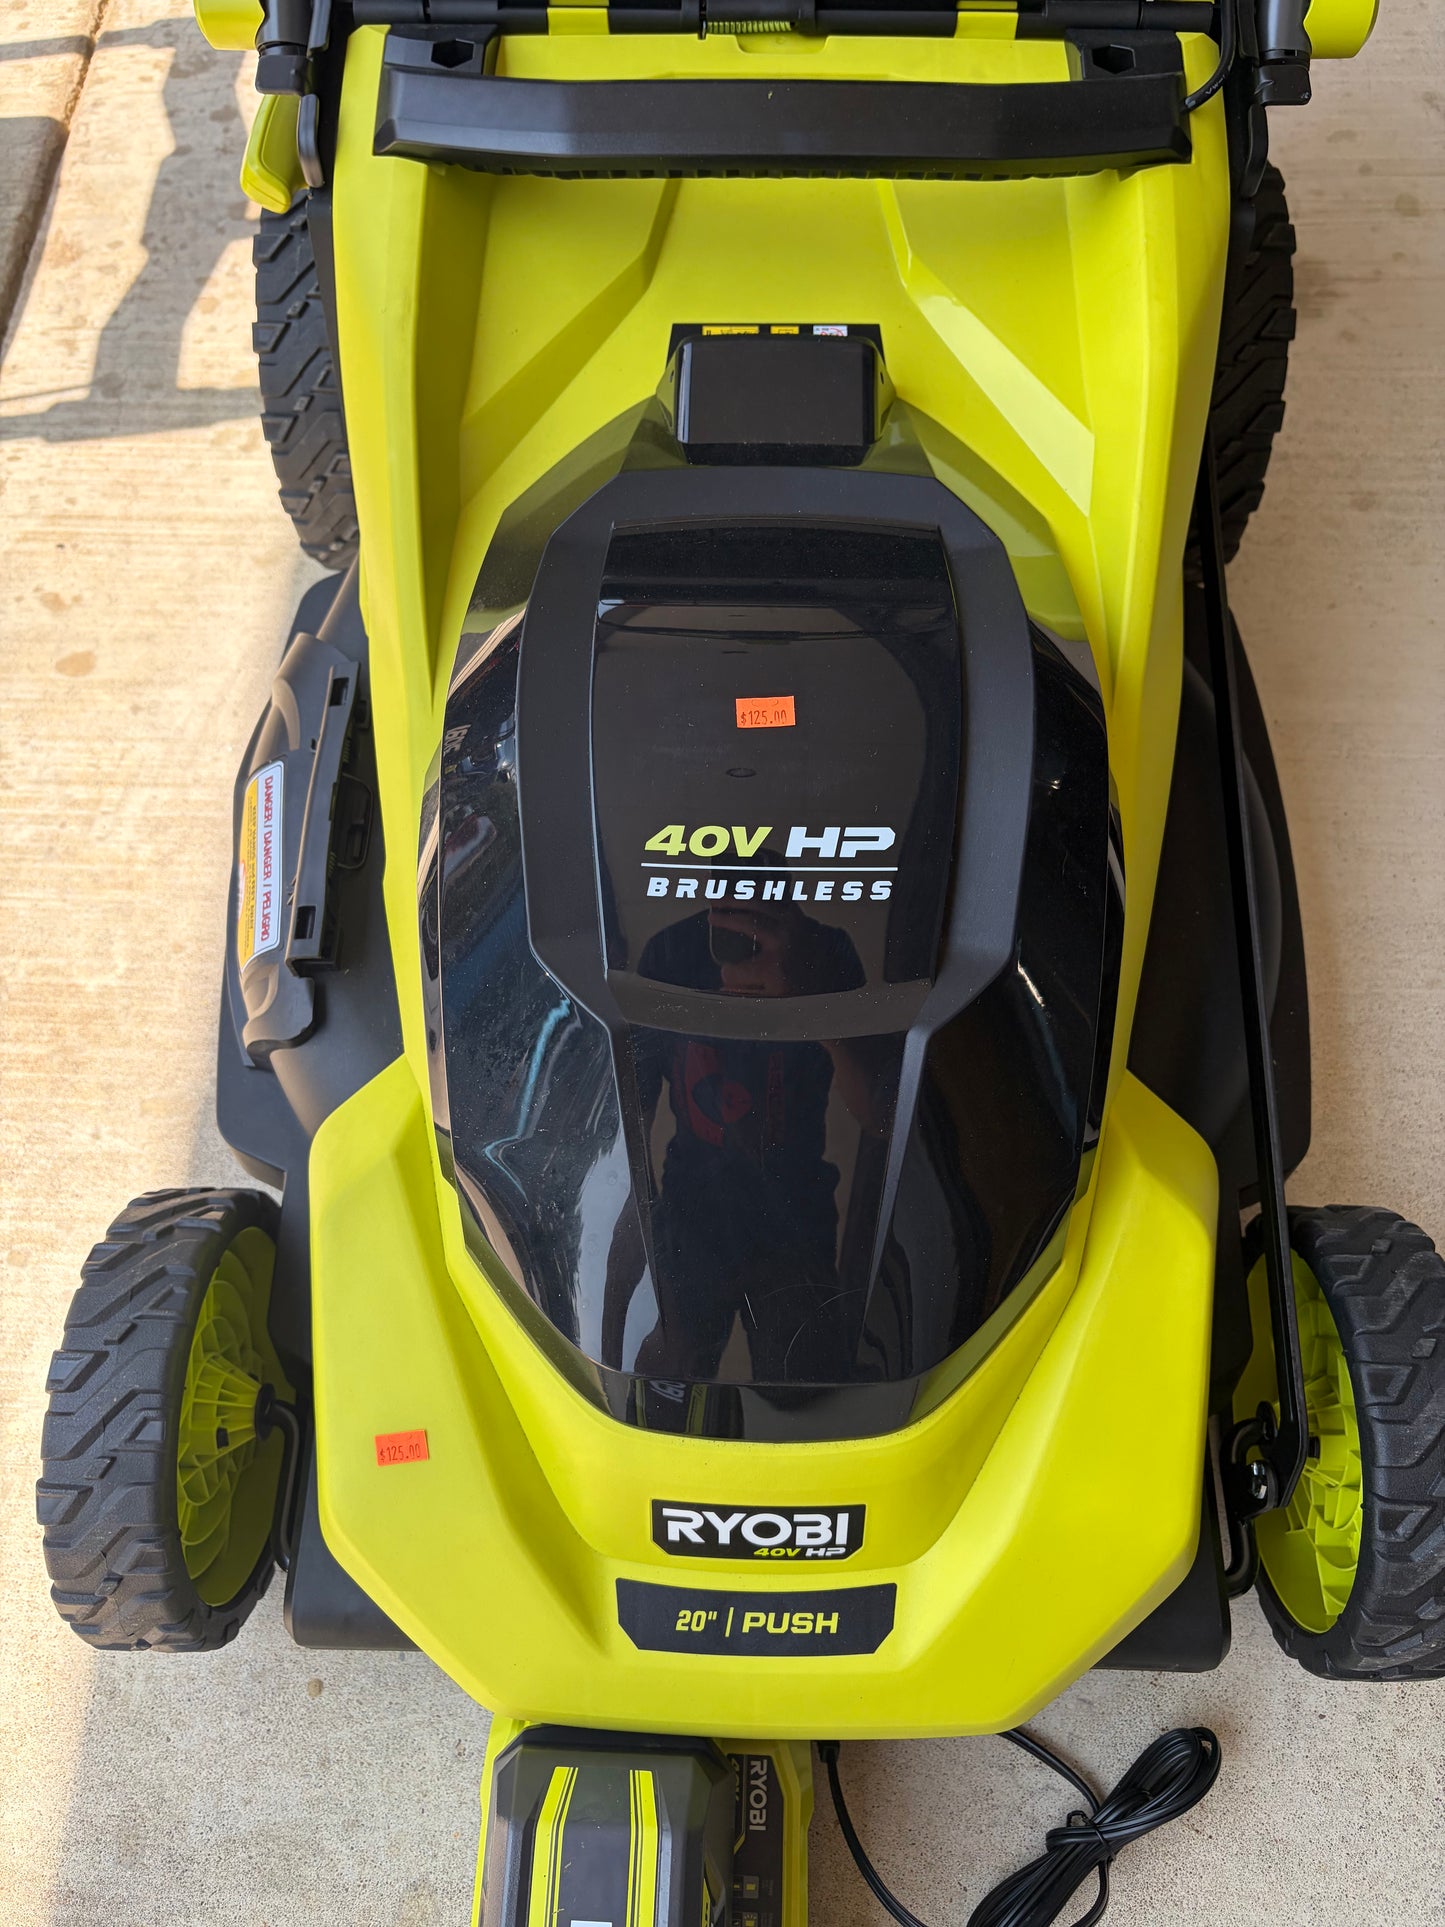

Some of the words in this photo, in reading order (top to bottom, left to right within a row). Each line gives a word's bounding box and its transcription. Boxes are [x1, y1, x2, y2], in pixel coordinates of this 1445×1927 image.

[741, 709, 787, 726] $125.00
[264, 775, 273, 824] DANGER
[263, 830, 273, 881] DANGER
[644, 824, 773, 858] 40V
[785, 826, 896, 858] HP
[646, 877, 893, 901] BRUSHLESS
[261, 891, 271, 941] PELIGRO
[380, 1443, 421, 1463] $125.00
[662, 1507, 850, 1547] RYOBI
[753, 1547, 801, 1557] 40V
[805, 1547, 846, 1557] HP
[675, 1610, 717, 1632] 20"
[742, 1611, 839, 1634] PUSH
[750, 1760, 767, 1830] RYOBI
